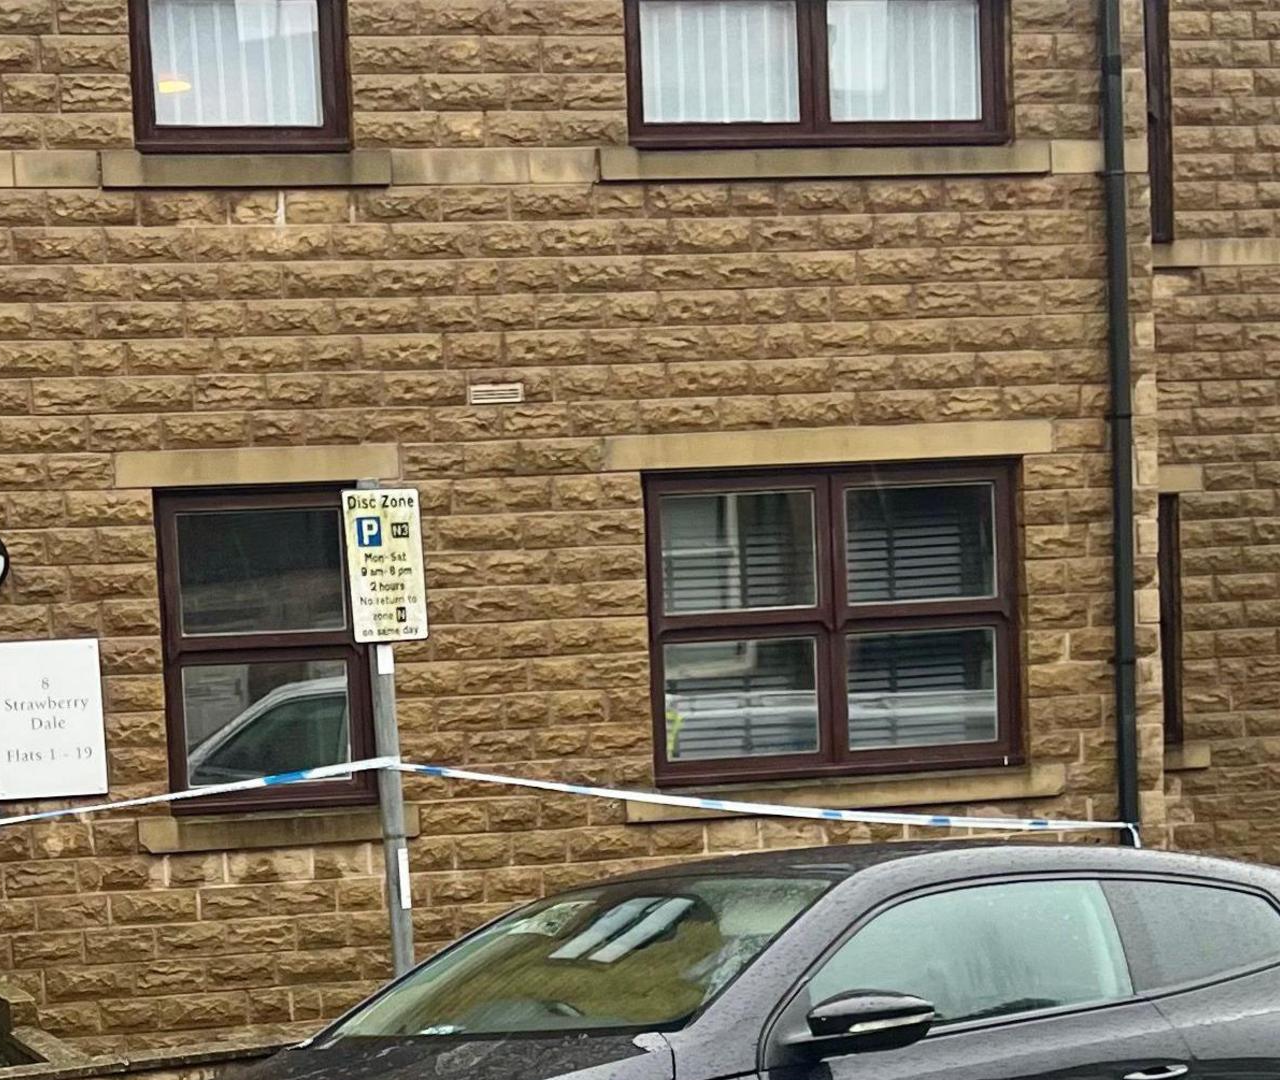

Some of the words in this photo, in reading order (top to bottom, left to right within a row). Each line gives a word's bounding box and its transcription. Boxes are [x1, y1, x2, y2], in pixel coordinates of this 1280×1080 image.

[347, 495, 376, 510] Disc
[381, 494, 414, 509] Zone
[370, 581, 377, 591] 2
[379, 582, 405, 591] hours
[360, 596, 373, 606] No
[376, 595, 405, 605] return
[408, 595, 417, 604] to
[362, 628, 374, 637] on
[377, 627, 400, 636] same
[403, 625, 419, 636] day
[40, 677, 50, 690] 8
[3, 695, 89, 712] Strawberry
[31, 715, 67, 731] Dale
[7, 748, 42, 763] Flats
[50, 748, 56, 761] 1
[76, 746, 93, 760] 19
